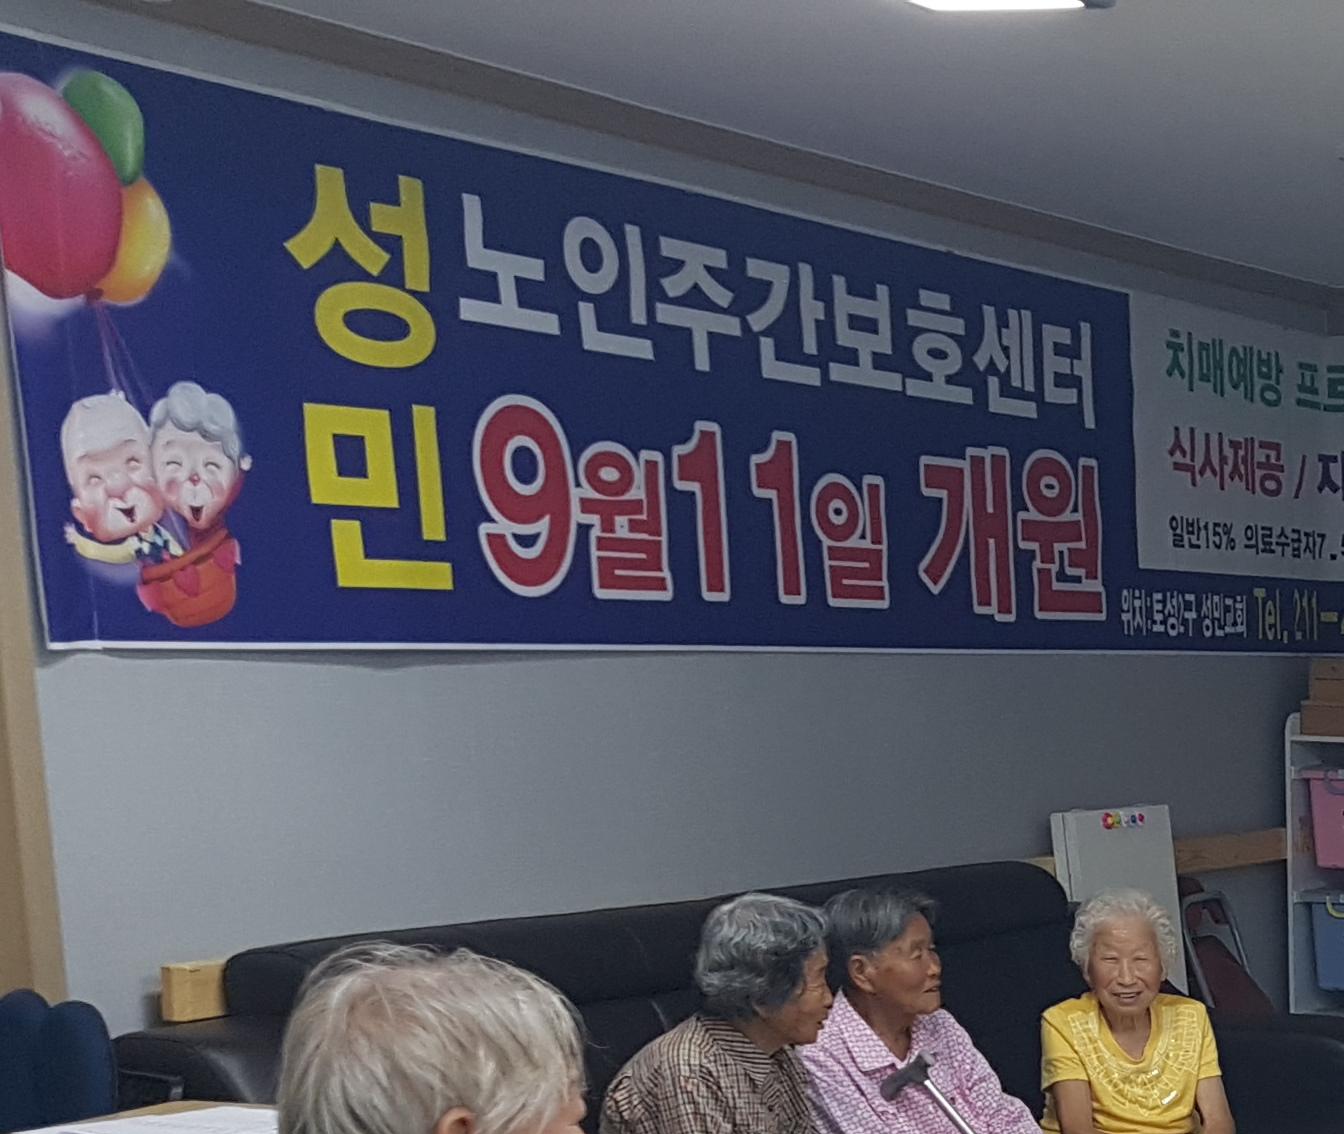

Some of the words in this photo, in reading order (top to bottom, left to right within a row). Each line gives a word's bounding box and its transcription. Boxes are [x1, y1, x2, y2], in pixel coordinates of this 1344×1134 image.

[458, 192, 1094, 430] 노인주간보호센터
[1164, 327, 1284, 408] 치매예방
[919, 446, 1107, 622] 개원
[1200, 592, 1248, 639] 성민교회
